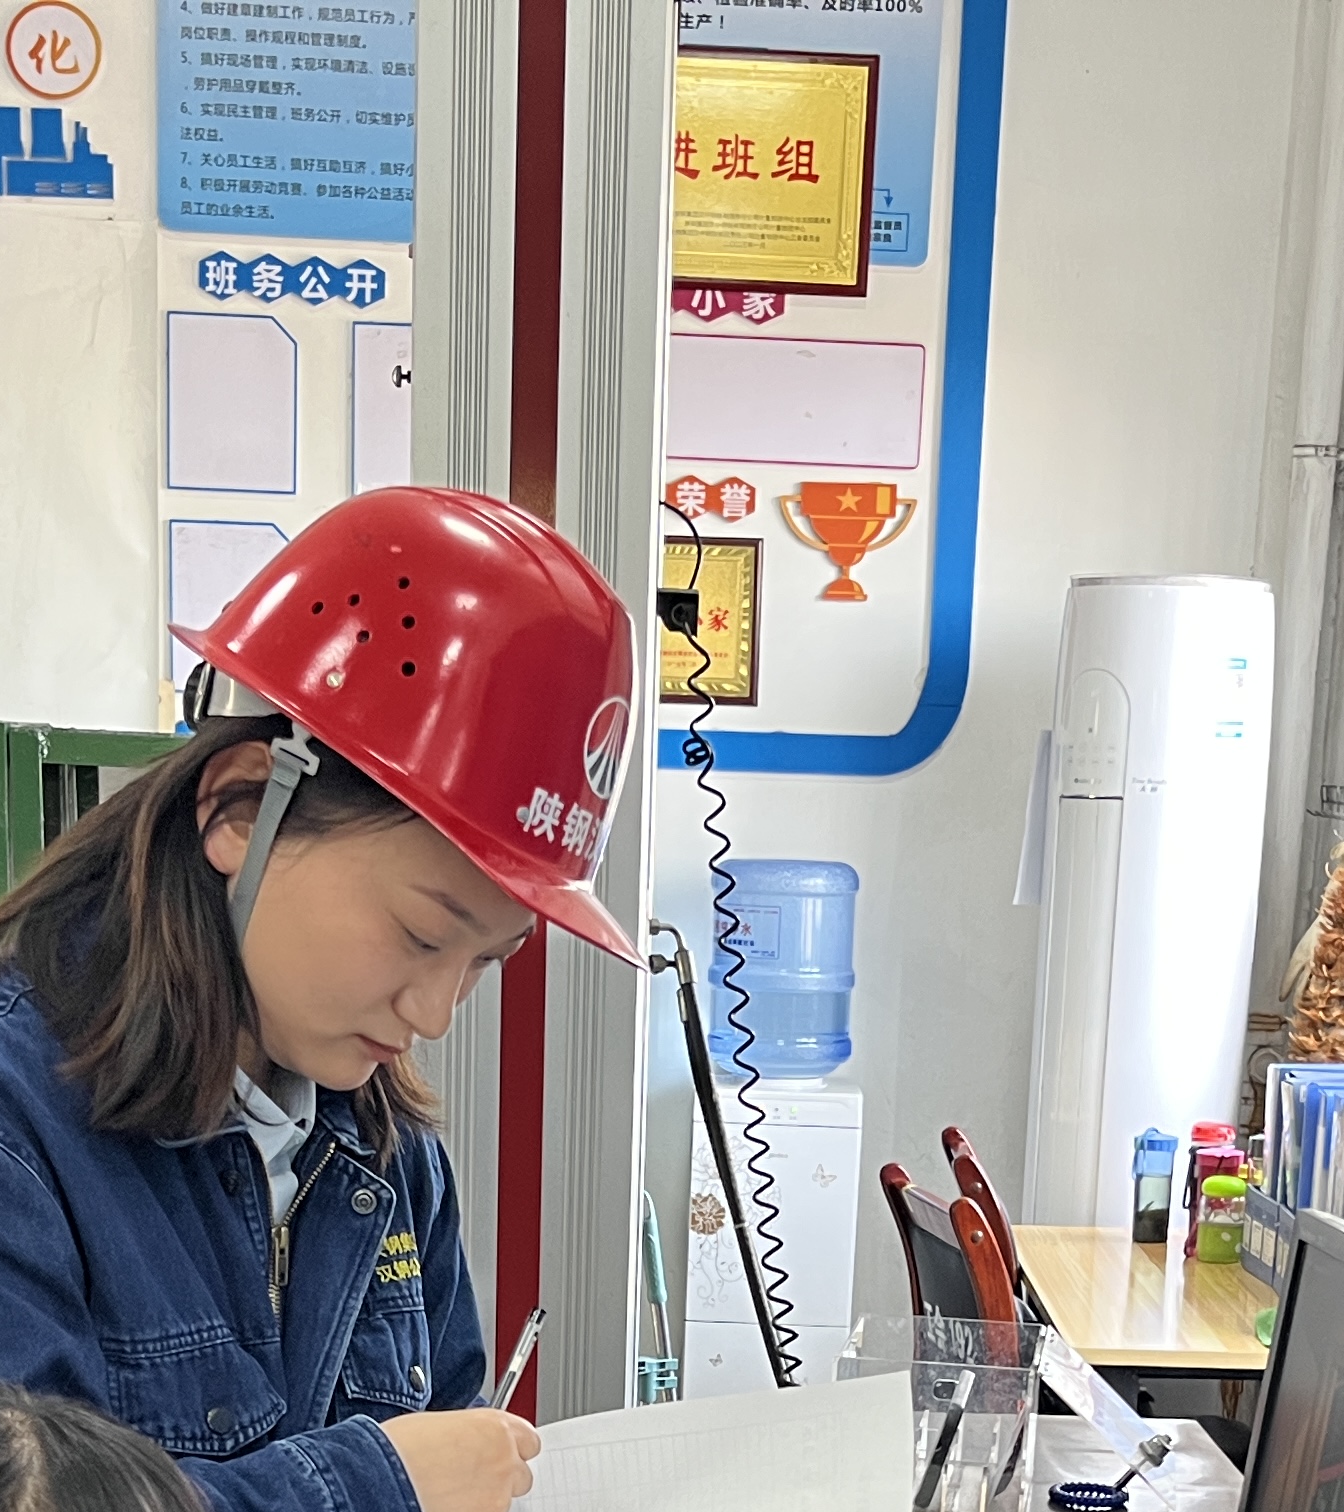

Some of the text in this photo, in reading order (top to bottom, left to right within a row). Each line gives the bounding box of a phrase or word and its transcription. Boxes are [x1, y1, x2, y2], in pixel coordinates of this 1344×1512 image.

[28, 29, 80, 75] 化
[205, 259, 378, 304] 班务公开
[676, 481, 751, 518] 荣誉
